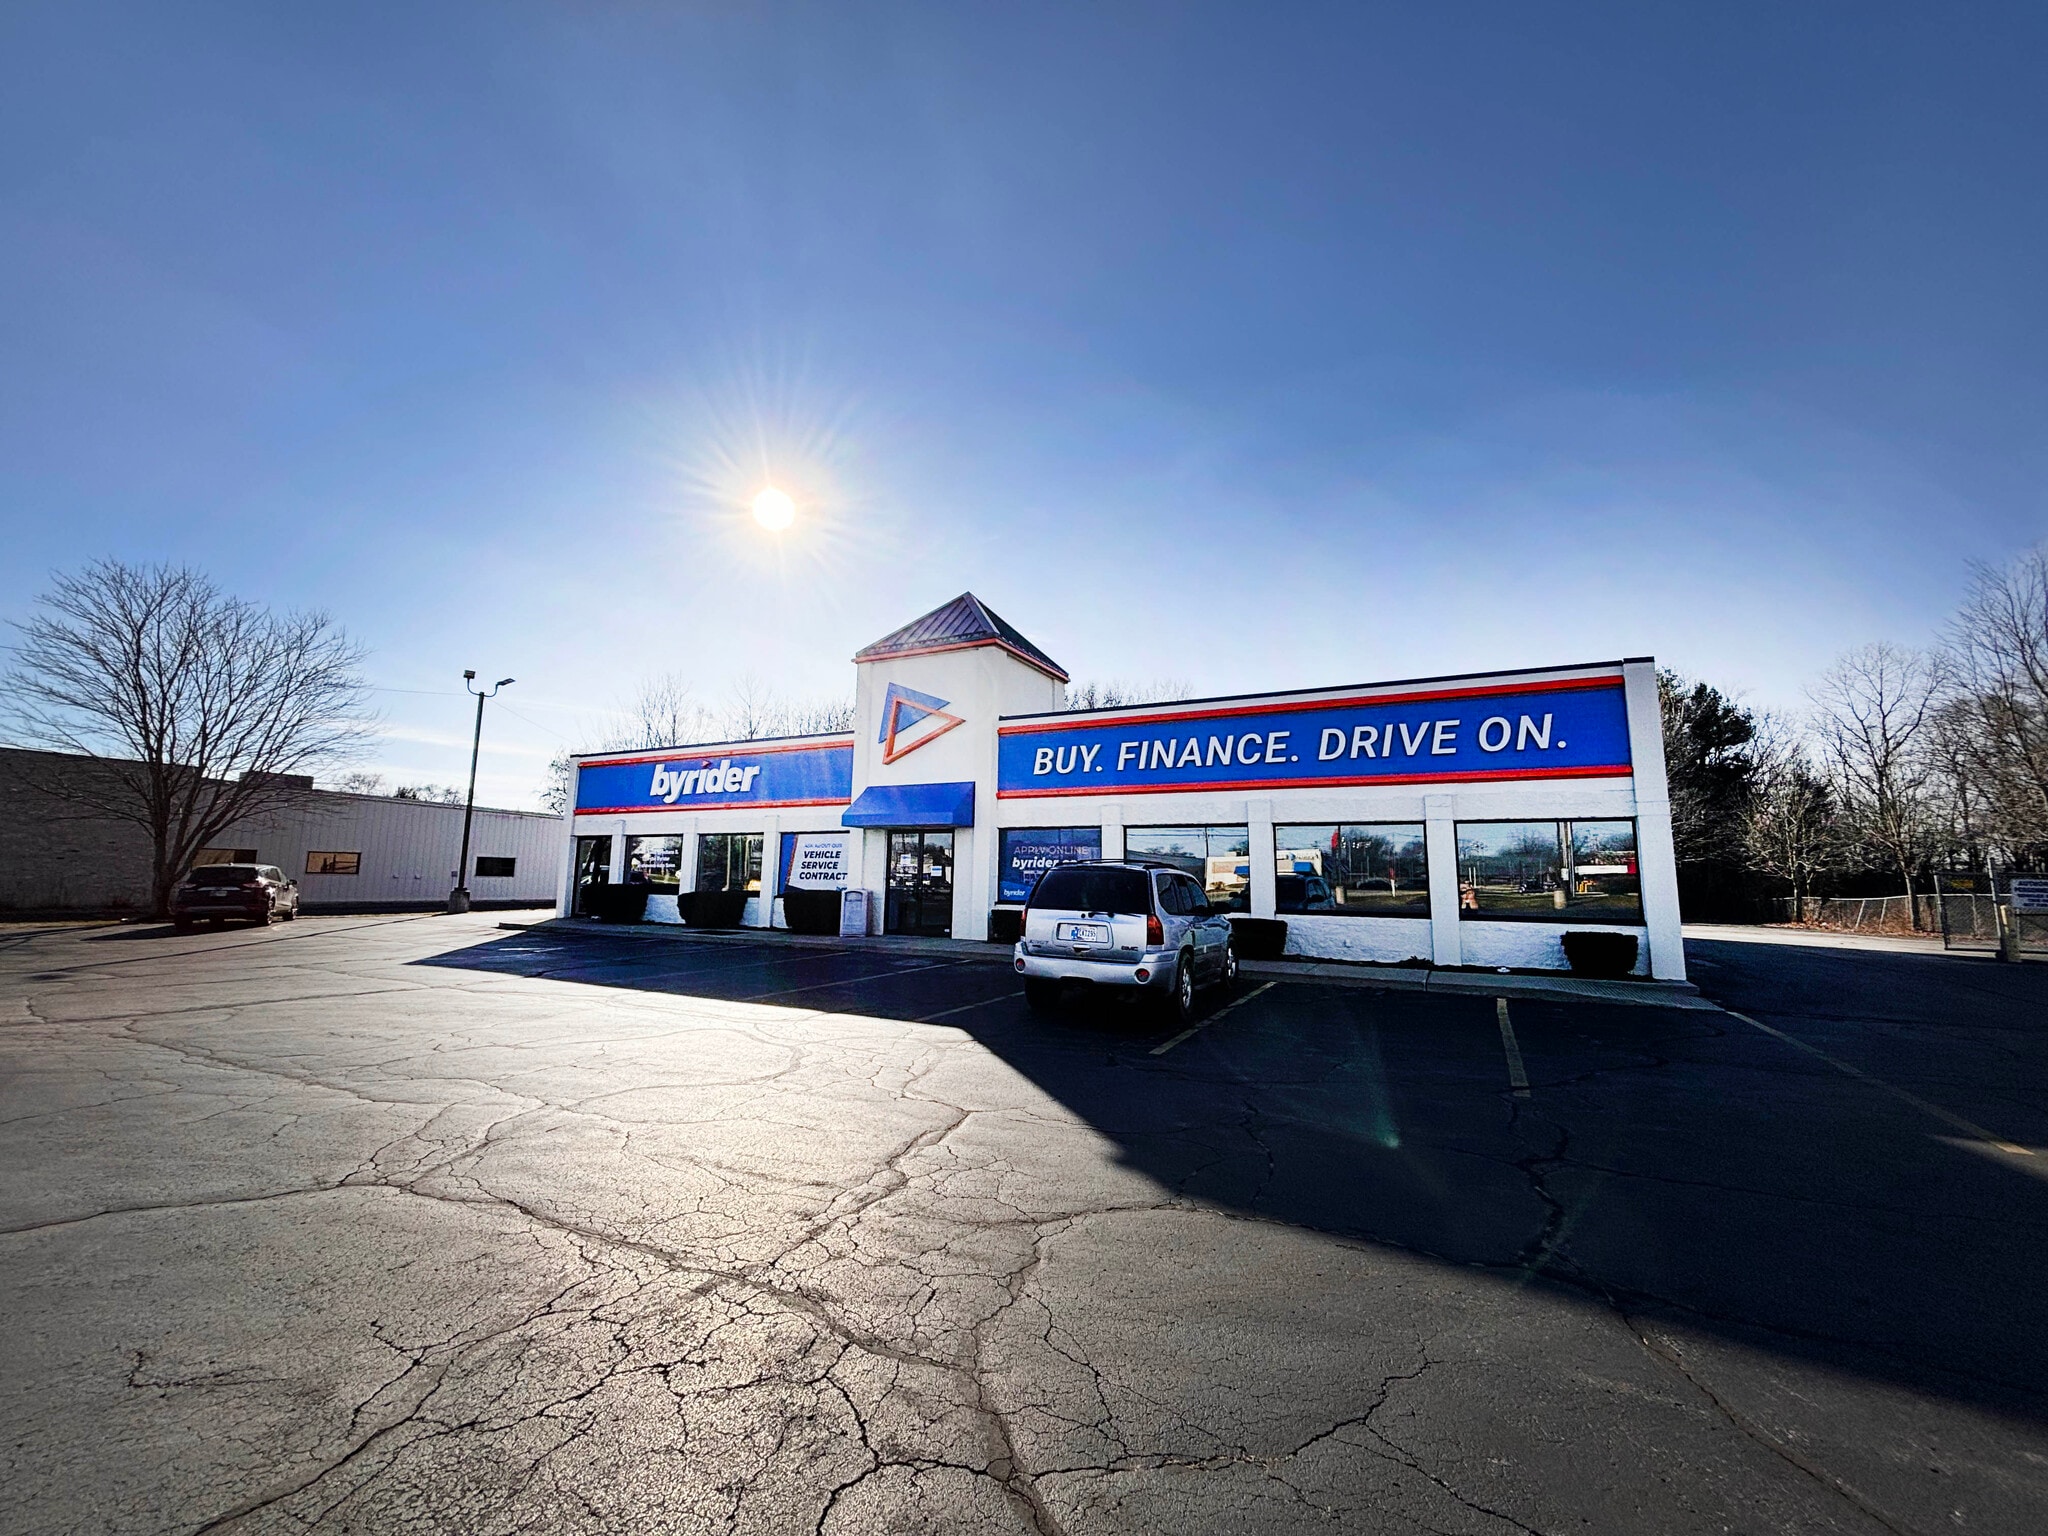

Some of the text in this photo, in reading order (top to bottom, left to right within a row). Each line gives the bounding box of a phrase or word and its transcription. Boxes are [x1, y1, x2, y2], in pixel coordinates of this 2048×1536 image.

[1033, 712, 1568, 776] BUY. FINANCE. DRIVE ON.
[649, 759, 761, 804] byrider
[803, 850, 842, 859] VEHICLE
[1048, 845, 1090, 855] ONLINE
[800, 861, 839, 870] SERVICE
[799, 871, 848, 881] CONTRACT
[1003, 889, 1026, 897] byrider
